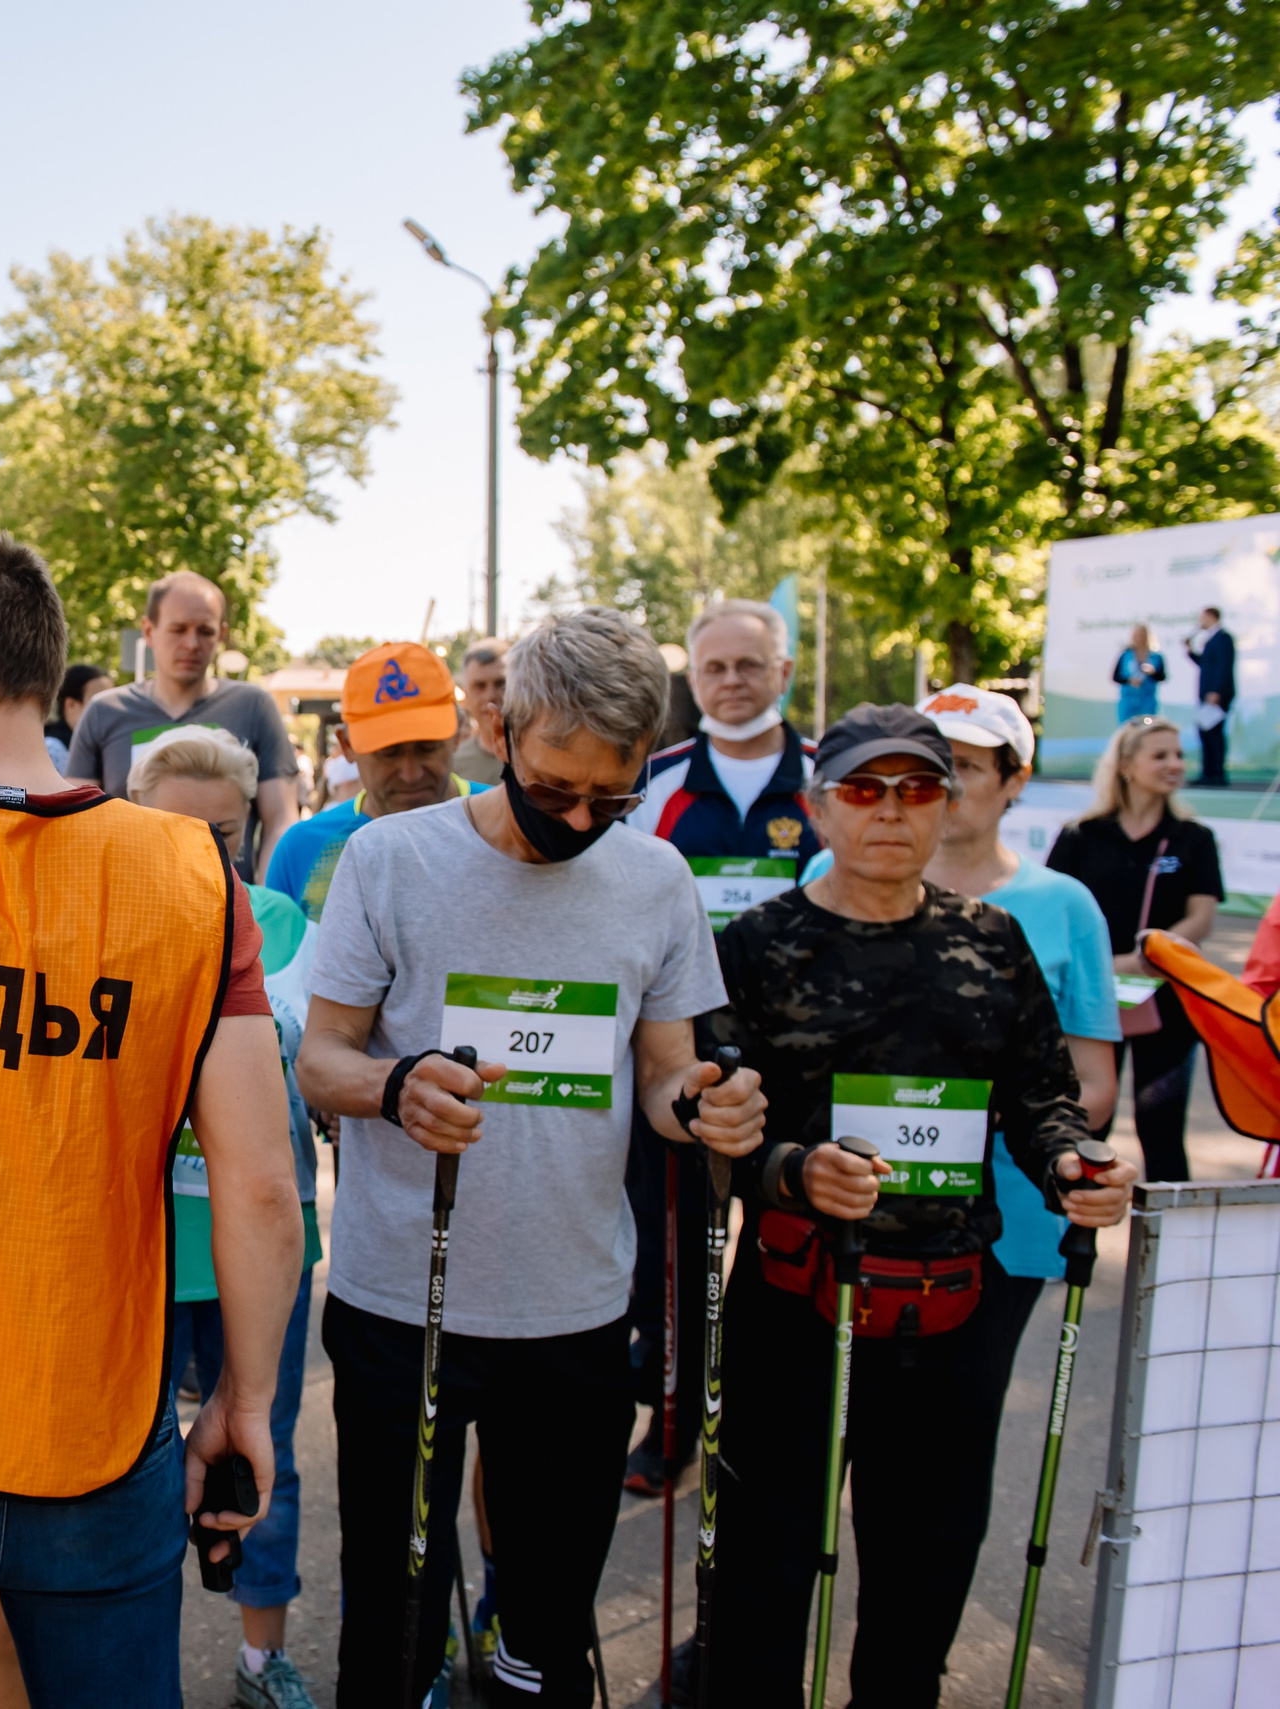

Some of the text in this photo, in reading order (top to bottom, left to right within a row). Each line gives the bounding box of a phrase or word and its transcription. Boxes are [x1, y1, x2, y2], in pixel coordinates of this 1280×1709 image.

[723, 889, 752, 904] 254
[509, 1031, 555, 1054] 207
[897, 1125, 940, 1147] 369
[431, 1275, 444, 1304] GEO
[706, 1272, 720, 1301] GEO
[429, 1307, 442, 1324] T3
[706, 1304, 719, 1321] T3
[1049, 1353, 1073, 1435] OUTVENTURE
